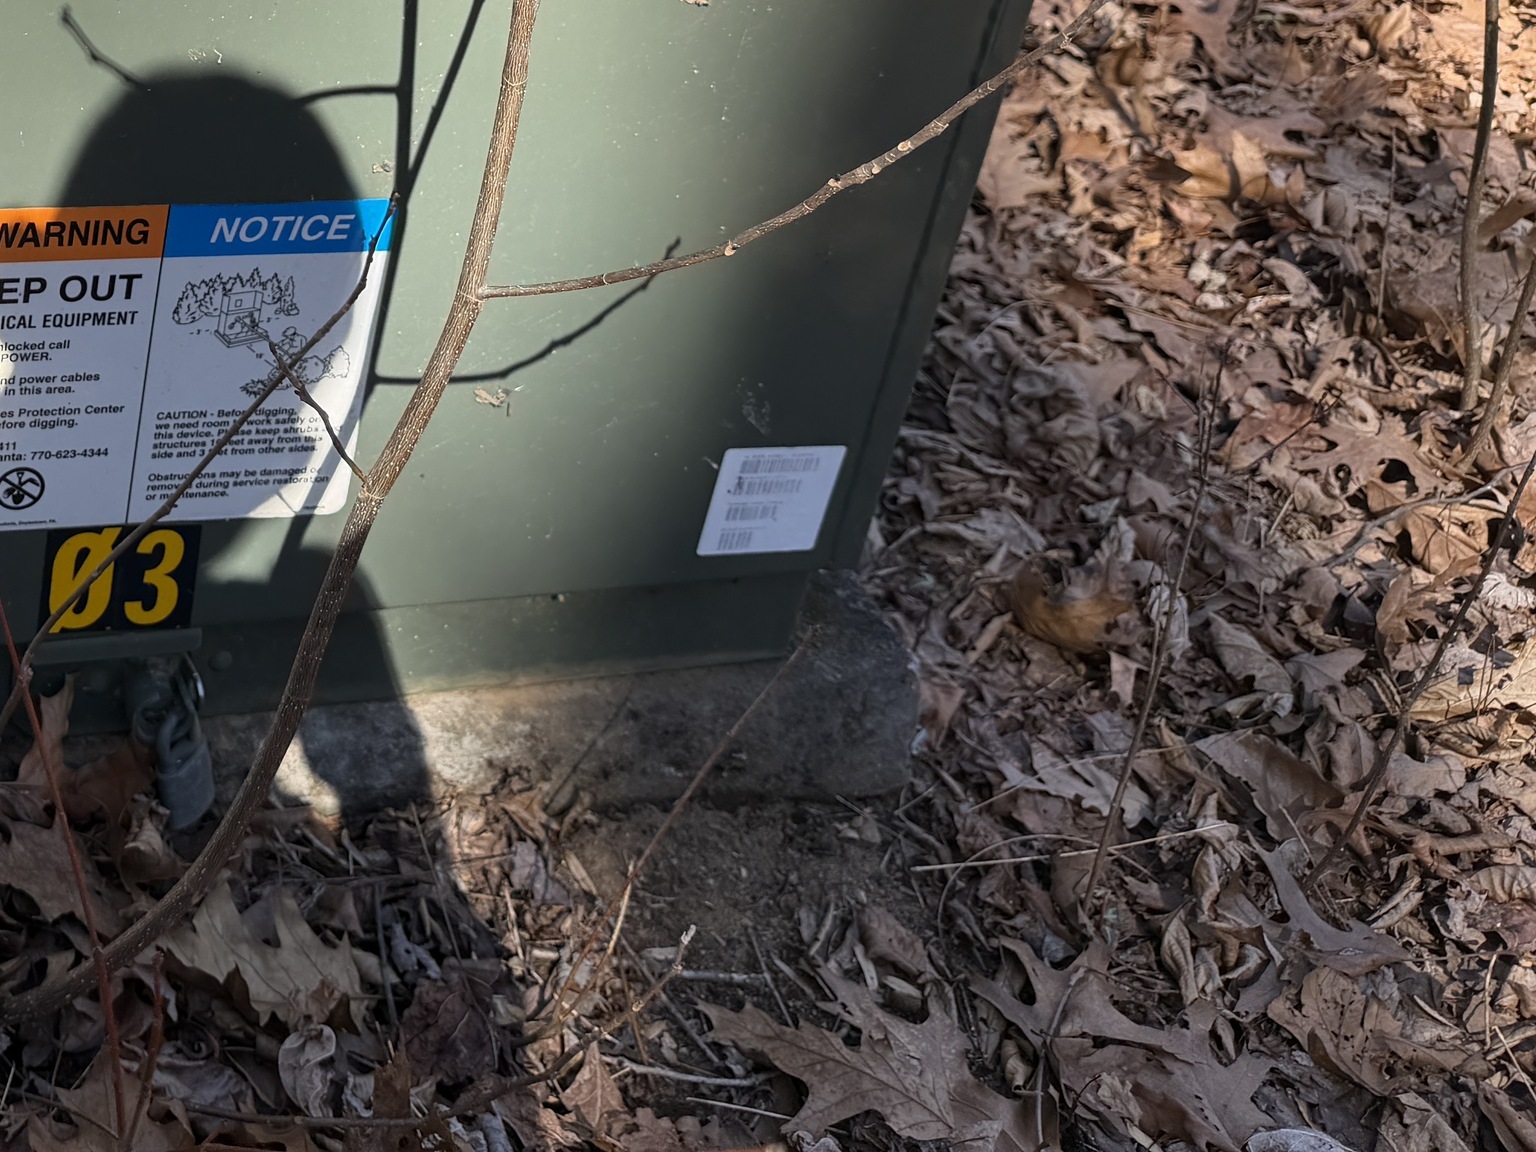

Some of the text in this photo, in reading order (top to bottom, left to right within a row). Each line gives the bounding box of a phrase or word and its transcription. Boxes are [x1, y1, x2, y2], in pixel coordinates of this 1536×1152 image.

[210, 214, 356, 244] NOTICE
[59, 273, 143, 303] OUT
[42, 310, 139, 328] EQUIPMENT
[48, 339, 71, 350] call
[0, 352, 53, 363] POWER.
[19, 374, 57, 387] power
[60, 372, 101, 383] cables
[4, 386, 15, 396] in
[19, 385, 42, 396] this
[45, 385, 76, 395] area.
[18, 405, 81, 418] Protection
[84, 404, 125, 415] Center
[156, 409, 208, 420] CAUTION
[217, 408, 248, 418] Befor
[28, 417, 79, 430] digging.
[155, 422, 170, 430] we
[173, 420, 199, 430] need
[202, 419, 230, 428] room
[246, 416, 272, 426] work
[274, 415, 305, 425] safely
[153, 431, 174, 440] this
[176, 429, 214, 439] device.
[217, 428, 252, 437] Plse
[254, 426, 281, 436] keep
[282, 424, 319, 434] shrubs
[152, 439, 207, 450] structures
[223, 436, 245, 446] eet
[247, 436, 275, 446] away
[277, 435, 301, 444] from
[304, 434, 323, 443] this
[30, 448, 109, 461] 770-623-4344
[151, 443, 318, 459] side and 3 et from other sides.
[148, 471, 217, 482] Obstrucons
[219, 470, 241, 479] may
[244, 468, 257, 477] be
[259, 465, 307, 477] damaged
[146, 475, 329, 491] remov during service restoraon
[145, 490, 229, 501] or mtenance.
